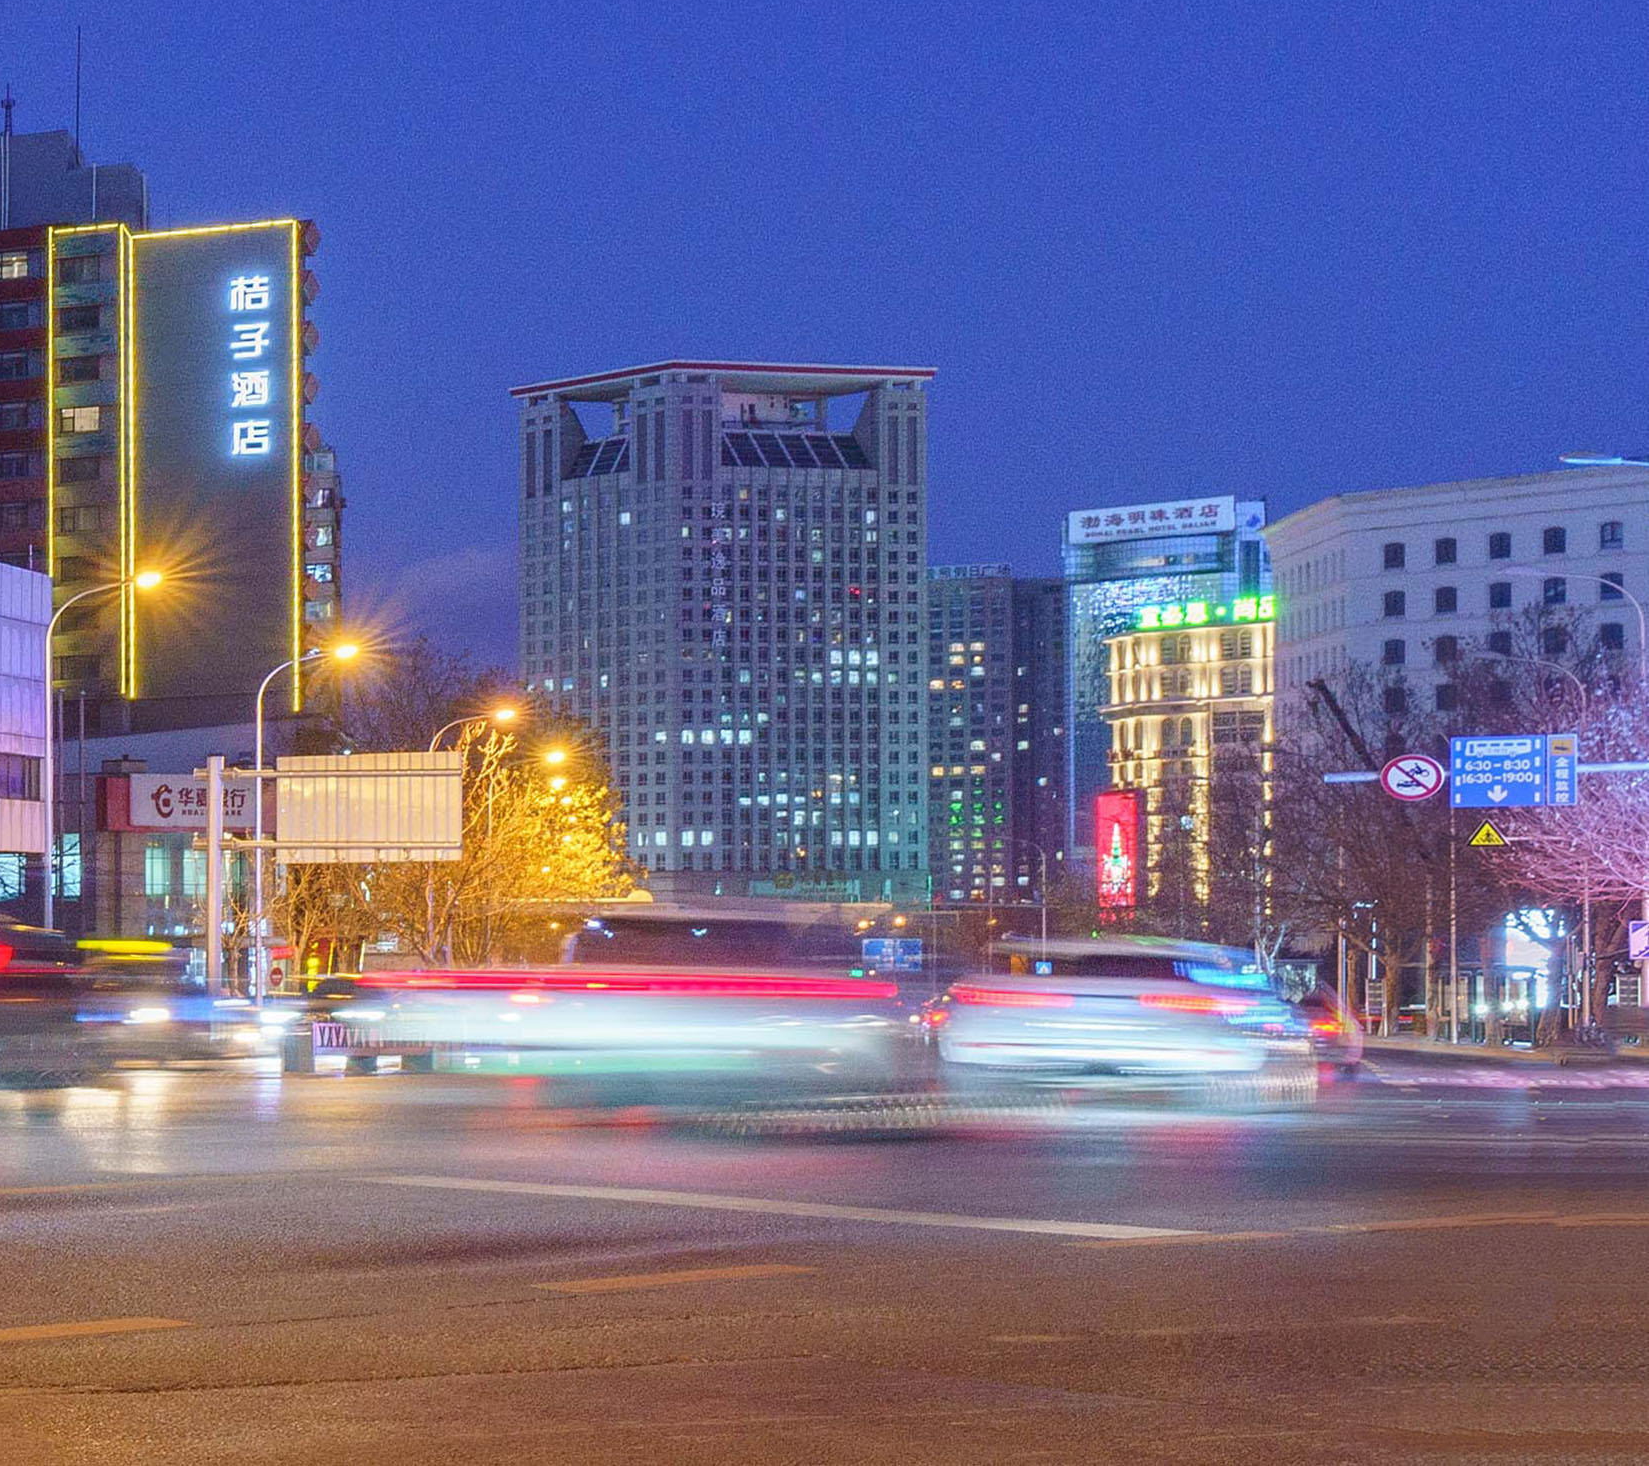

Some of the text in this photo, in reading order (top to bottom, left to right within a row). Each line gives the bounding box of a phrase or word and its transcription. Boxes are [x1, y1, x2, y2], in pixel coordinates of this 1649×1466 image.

[229, 275, 270, 456] 桔子酒店
[1080, 504, 1221, 529] 渤海明珠酒店
